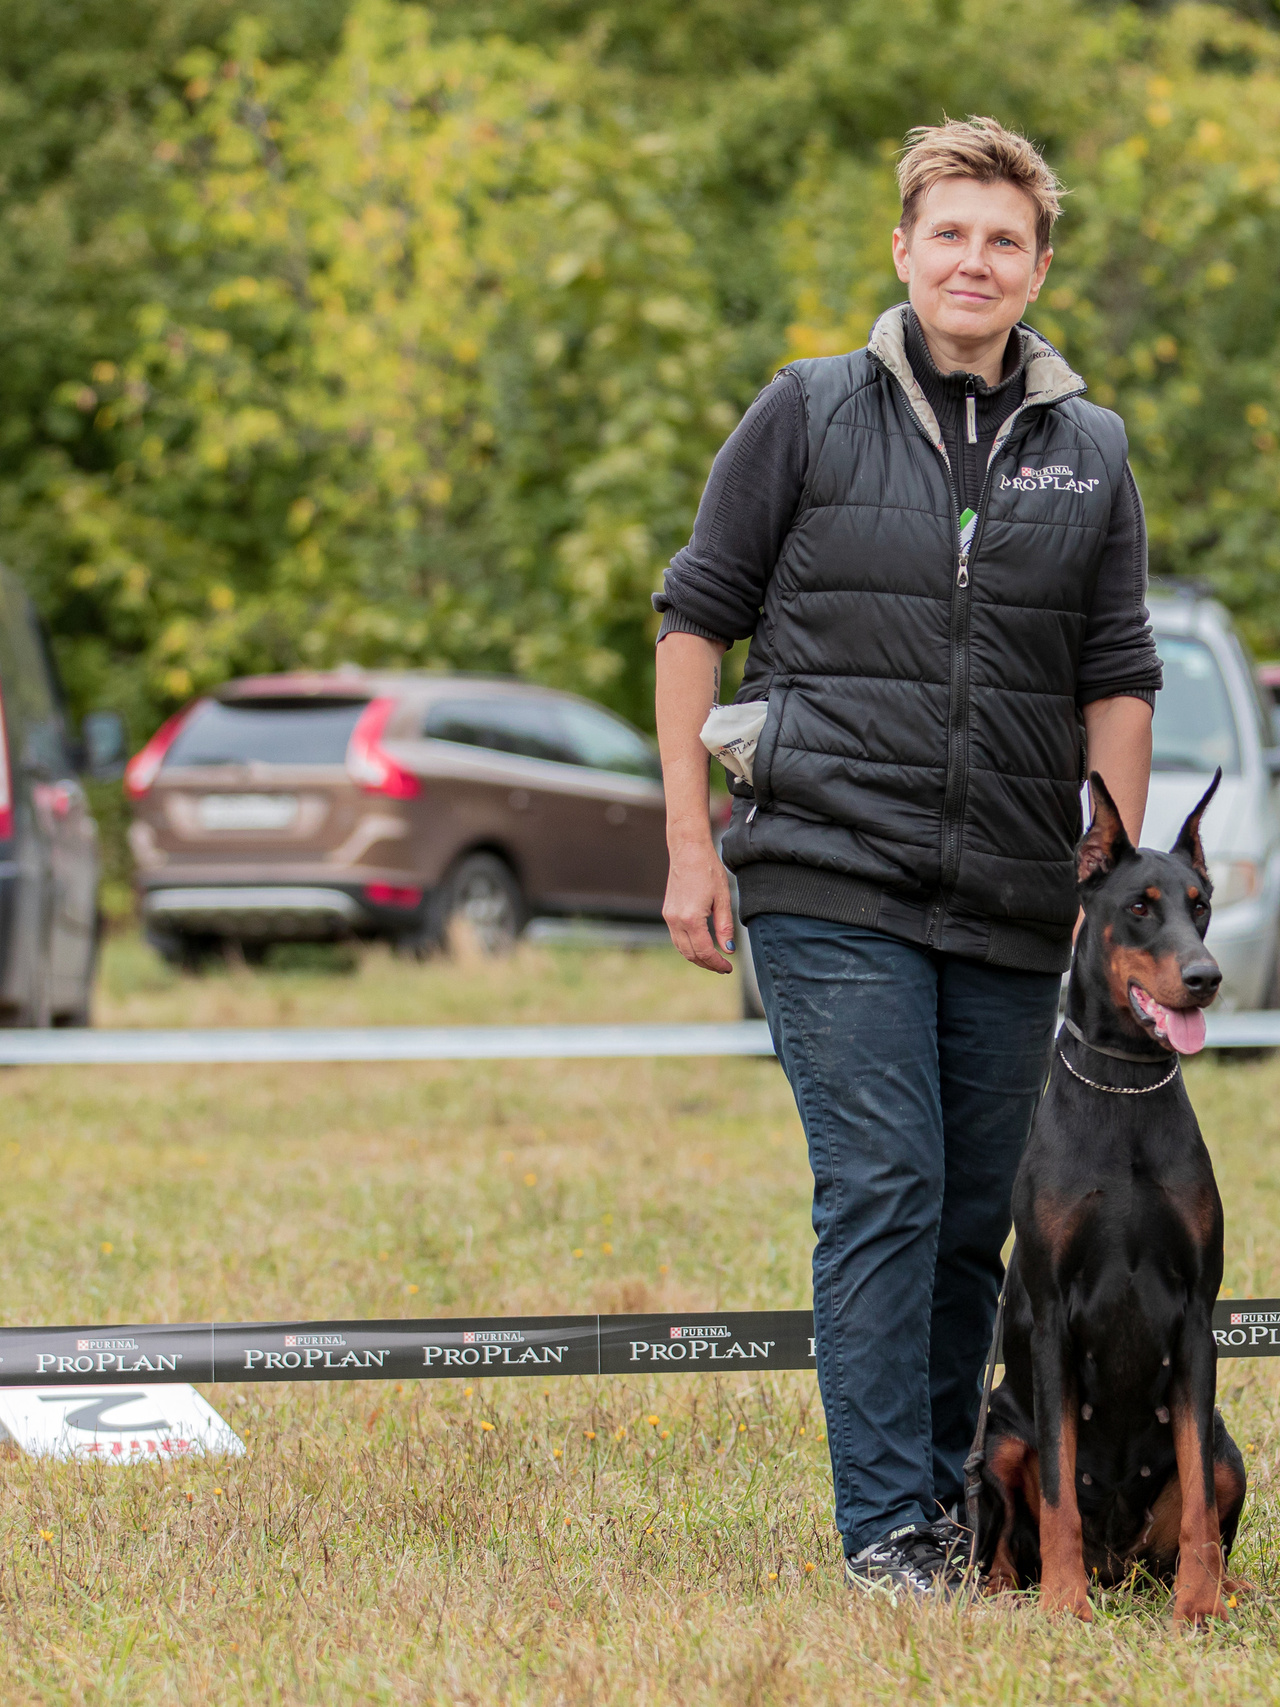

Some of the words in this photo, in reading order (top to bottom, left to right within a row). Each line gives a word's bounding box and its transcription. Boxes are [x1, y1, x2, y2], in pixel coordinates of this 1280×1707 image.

[474, 1331, 519, 1342] PURINA
[681, 1327, 726, 1337] PURINA
[88, 1339, 133, 1350] PURINA
[296, 1335, 341, 1346] PURINA
[897, 1524, 916, 1537] asics
